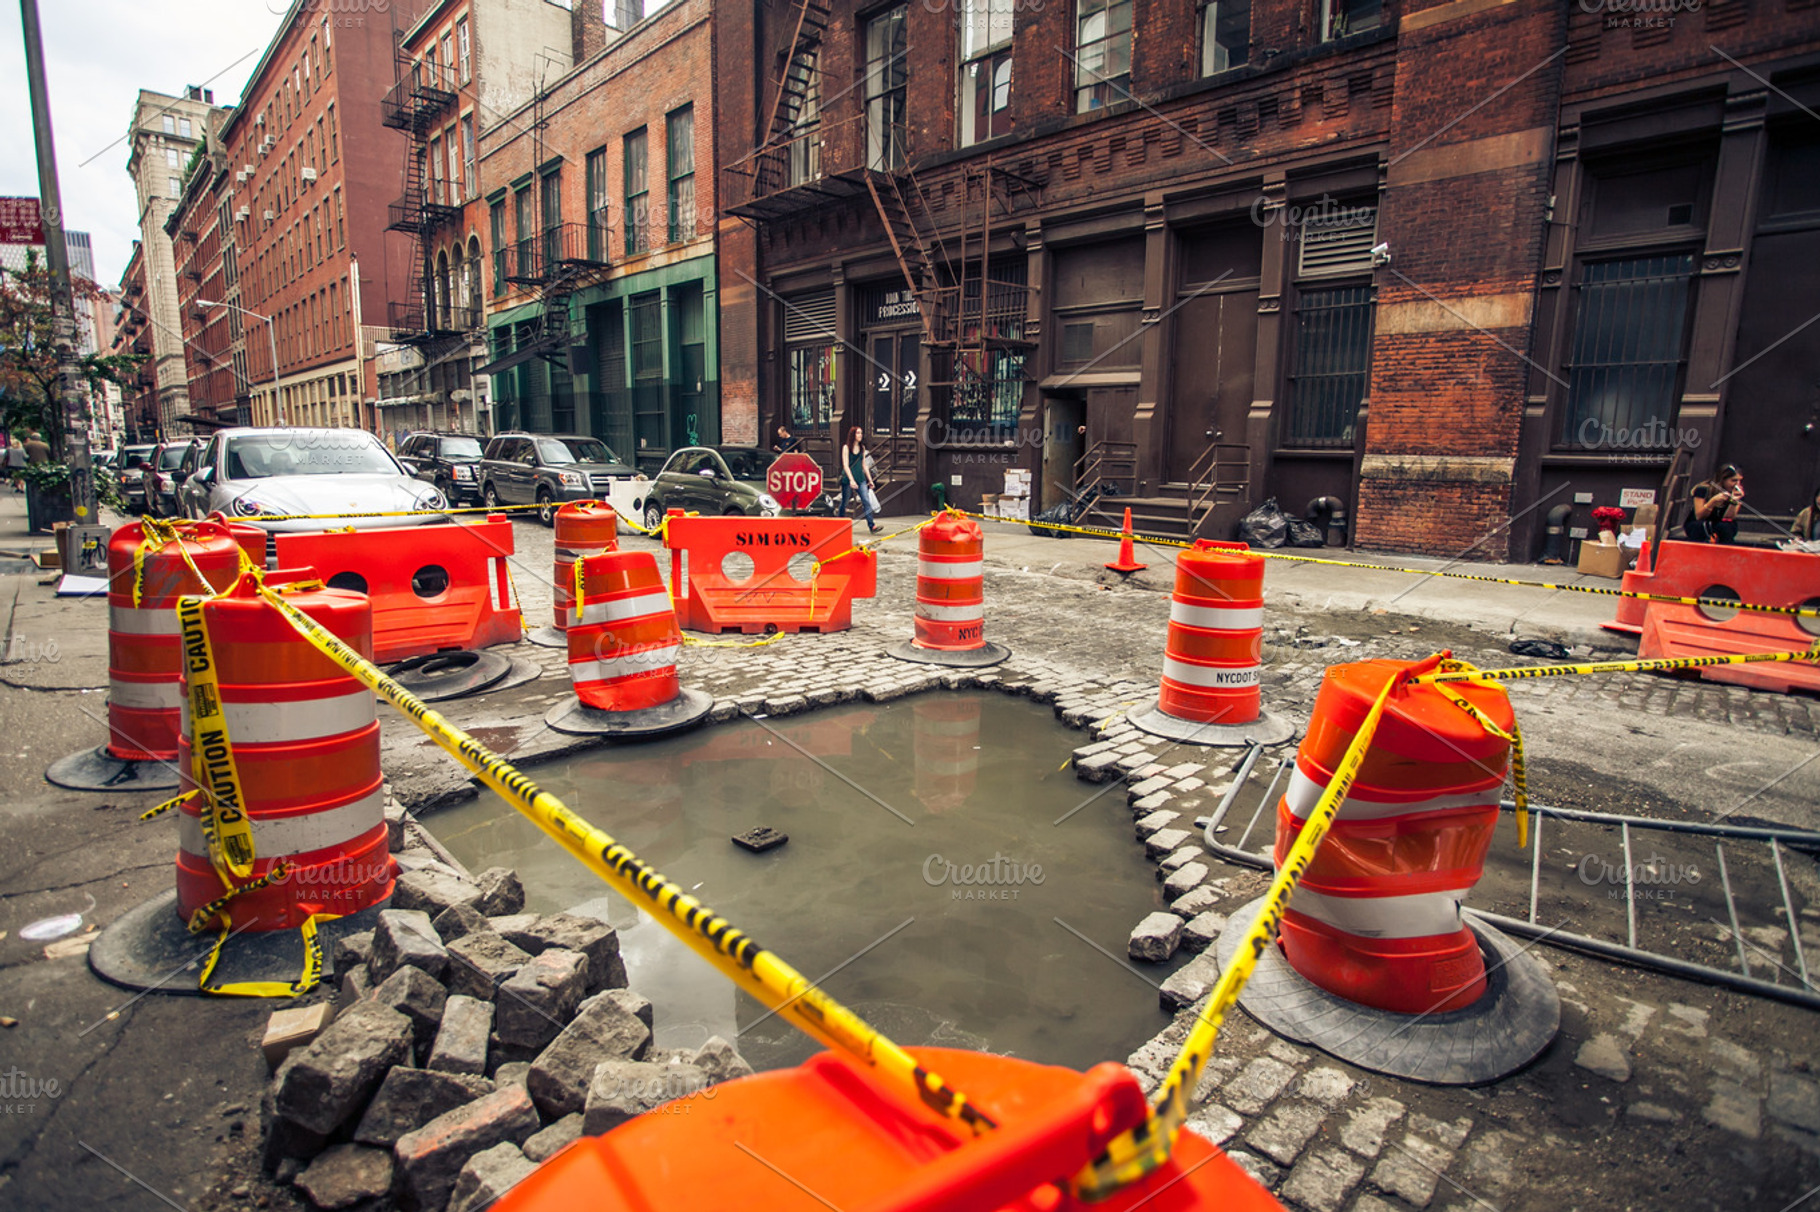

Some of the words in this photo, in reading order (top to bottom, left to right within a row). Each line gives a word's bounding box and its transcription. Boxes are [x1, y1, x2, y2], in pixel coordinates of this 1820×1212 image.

[770, 470, 819, 493] STOP
[1623, 490, 1653, 499] STAND
[735, 531, 811, 547] SIMONS
[180, 597, 210, 674] CAUTIO
[959, 627, 978, 640] NYC
[1216, 671, 1251, 684] NYCDOT
[200, 729, 242, 825] CAUTION
